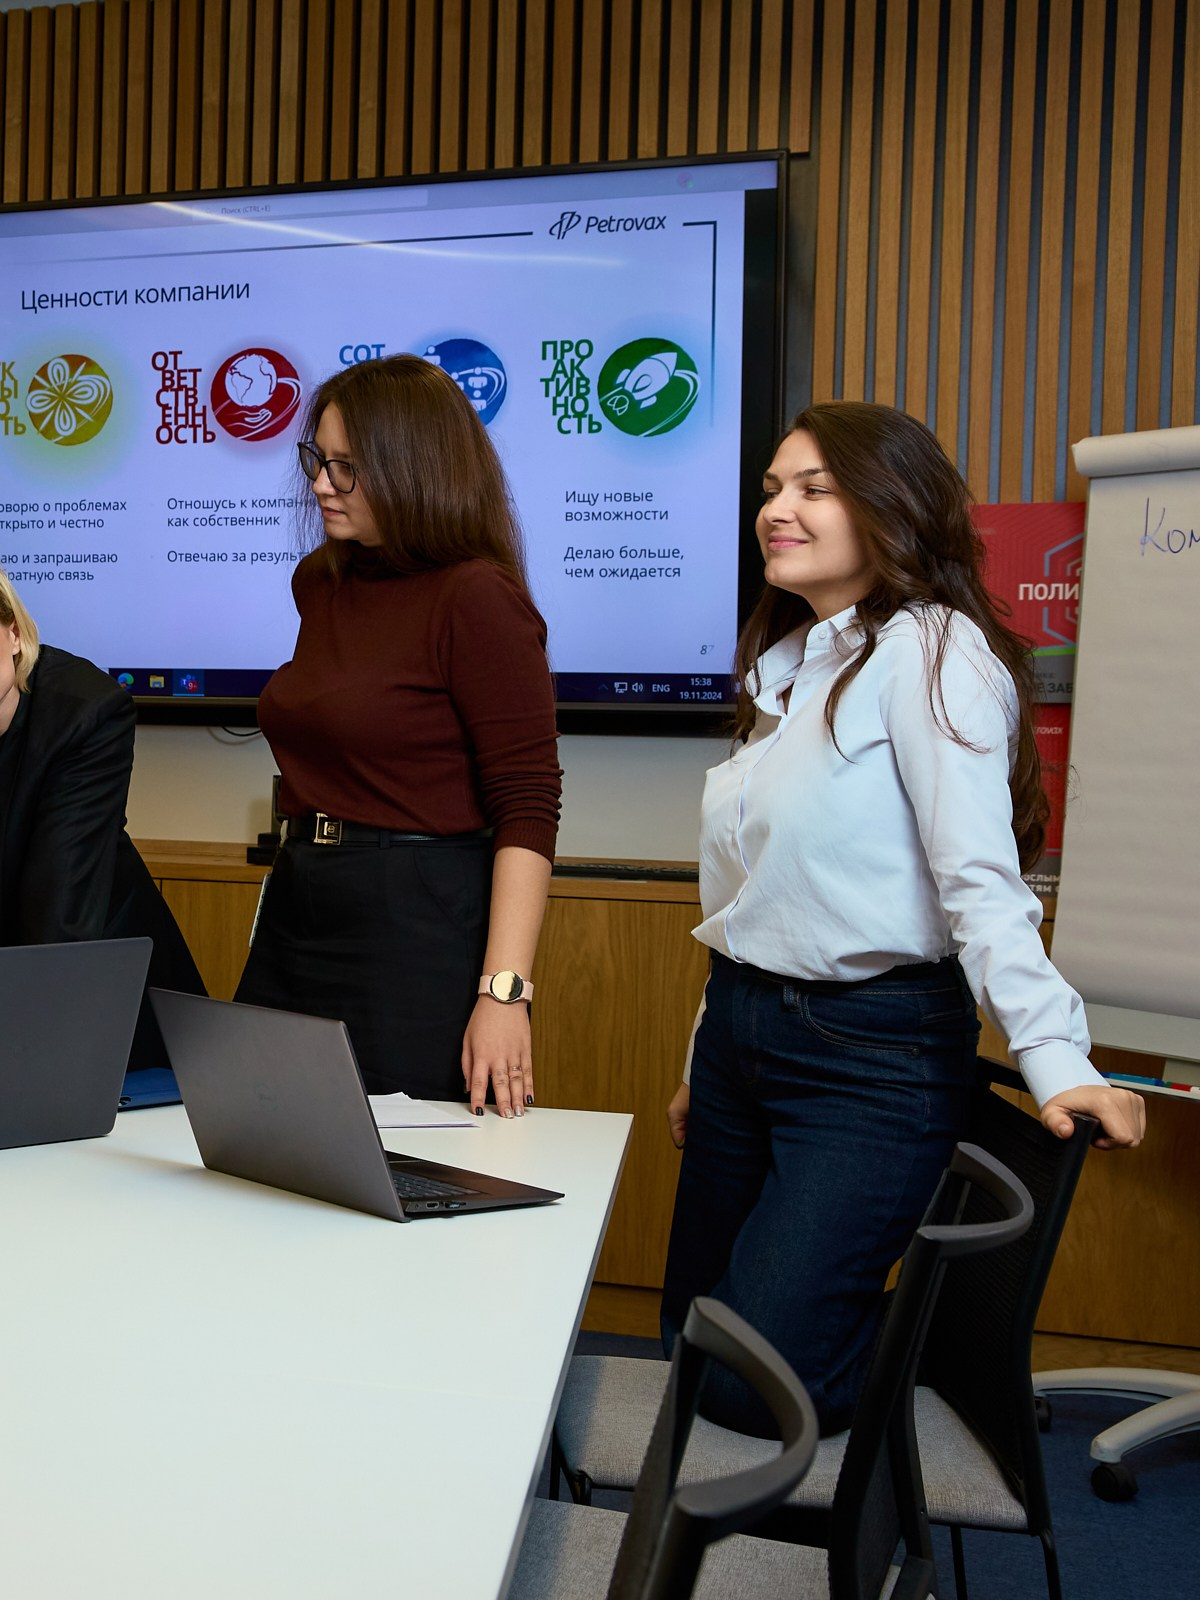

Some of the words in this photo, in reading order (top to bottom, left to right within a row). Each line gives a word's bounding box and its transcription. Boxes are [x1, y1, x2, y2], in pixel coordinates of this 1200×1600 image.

[585, 215, 667, 234] Petrovax
[21, 289, 128, 314] Ценности
[134, 282, 250, 305] компании
[339, 344, 386, 365] СОТ
[542, 339, 594, 360] ПРО
[151, 351, 183, 371] ОТ
[550, 358, 587, 380] АК
[162, 368, 202, 389] ВЕТ
[540, 377, 591, 398] ТИВ
[156, 387, 198, 407] СТВ
[552, 396, 589, 416] НО
[557, 414, 602, 434] СТЬ
[156, 423, 216, 444] ОСТЬ
[167, 497, 237, 513] Отношусь
[240, 499, 247, 509] к
[251, 498, 316, 509] компан
[565, 490, 599, 505] Ищу
[604, 491, 654, 503] новые
[43, 502, 51, 512] о
[55, 499, 127, 515] проблемах
[48, 519, 56, 529] и
[59, 518, 105, 529] честно
[167, 517, 190, 528] как
[193, 513, 280, 528] собственник
[565, 510, 669, 522] возможности
[22, 554, 30, 564] и
[33, 553, 118, 566] запрашиваю
[167, 550, 228, 564] Отвечаю
[231, 552, 247, 563] за
[564, 546, 615, 562] Делаю
[619, 545, 684, 561] больше,
[7, 571, 55, 585] ратную
[58, 571, 95, 582] связь
[565, 568, 594, 578] чем
[599, 567, 681, 581] ожидается
[652, 684, 671, 693] ENG
[690, 678, 712, 686] 15:38
[680, 691, 722, 700] 19.11.2024
